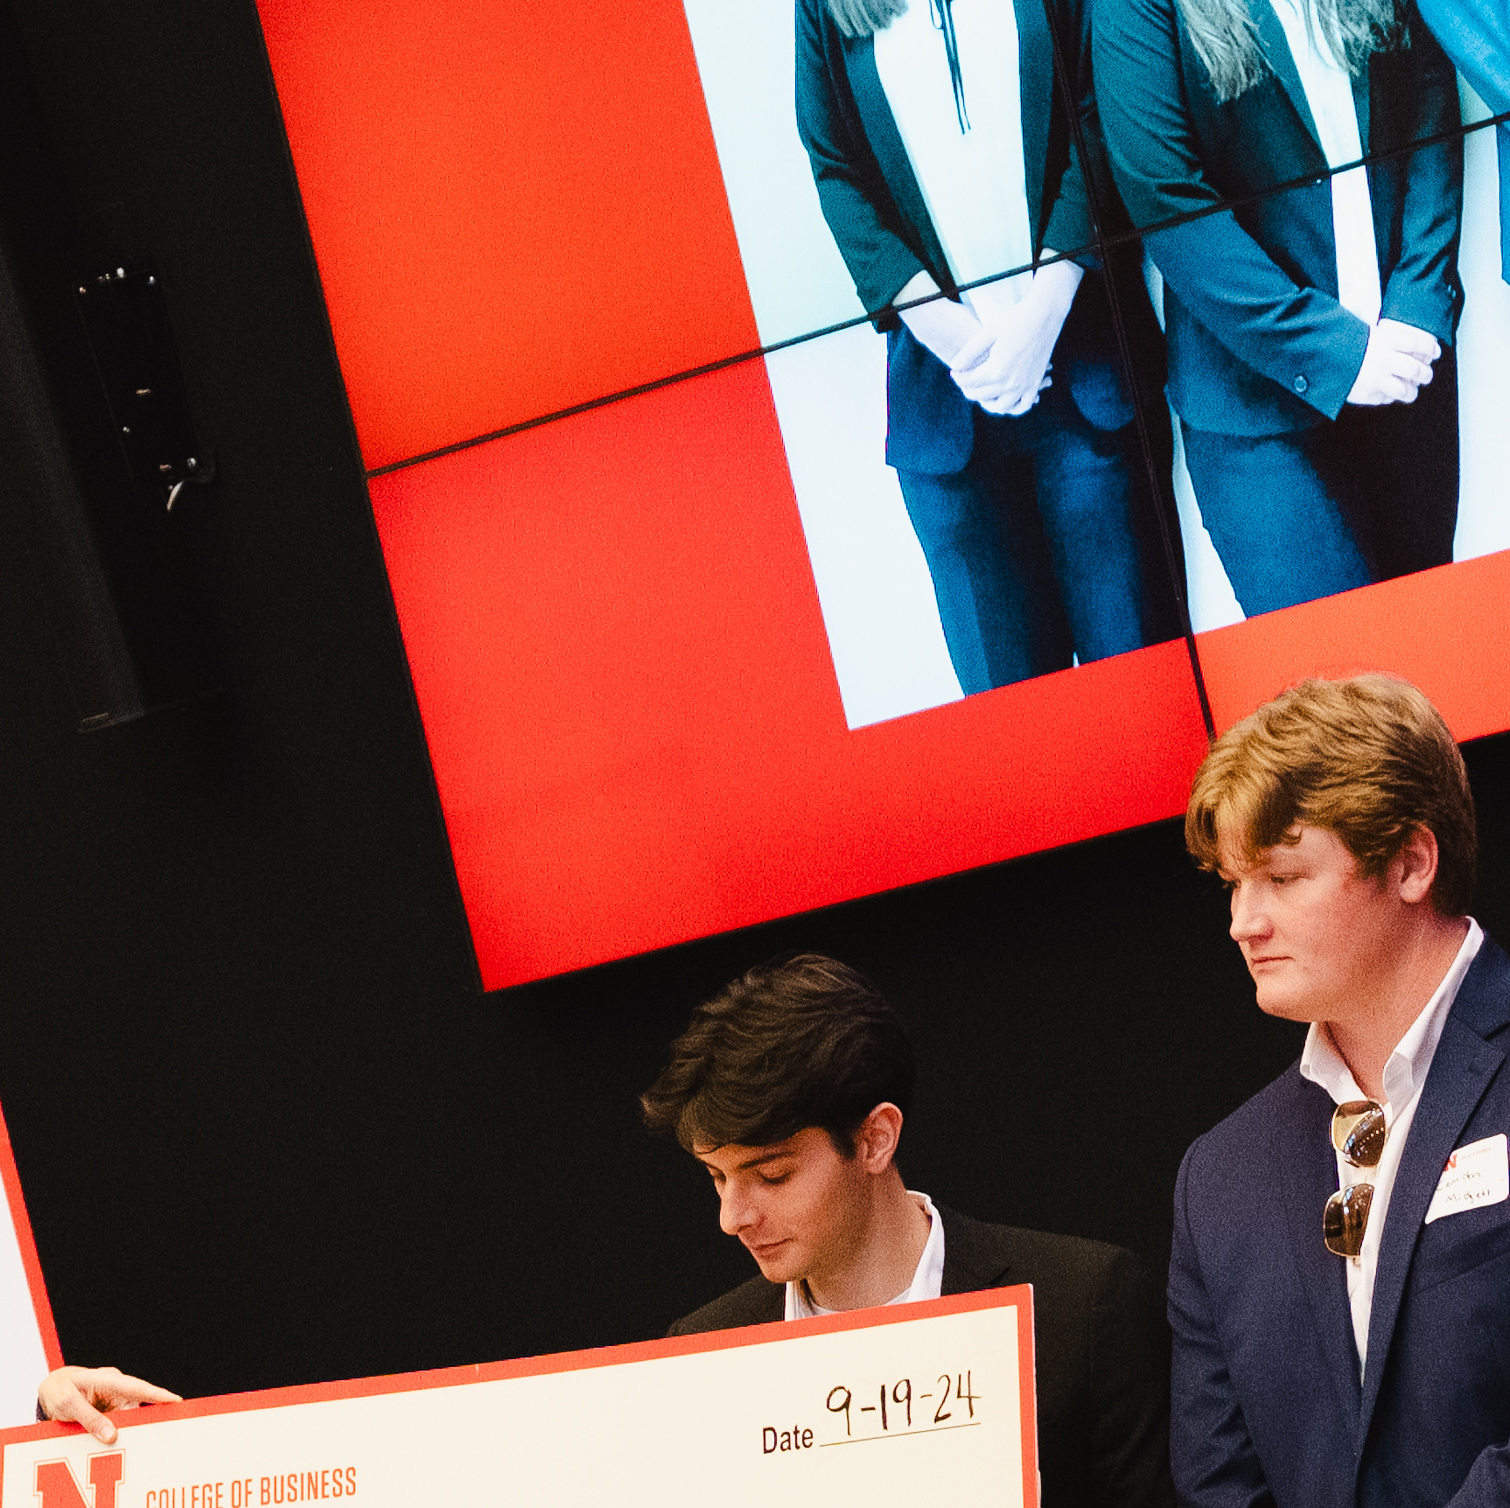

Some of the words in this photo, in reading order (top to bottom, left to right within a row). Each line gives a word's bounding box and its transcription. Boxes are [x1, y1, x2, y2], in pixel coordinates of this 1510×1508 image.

[761, 1424, 815, 1455] Date
[825, 1370, 982, 1437] 9-19-24
[231, 1478, 253, 1508] OF
[260, 1466, 357, 1505] BUSINESS
